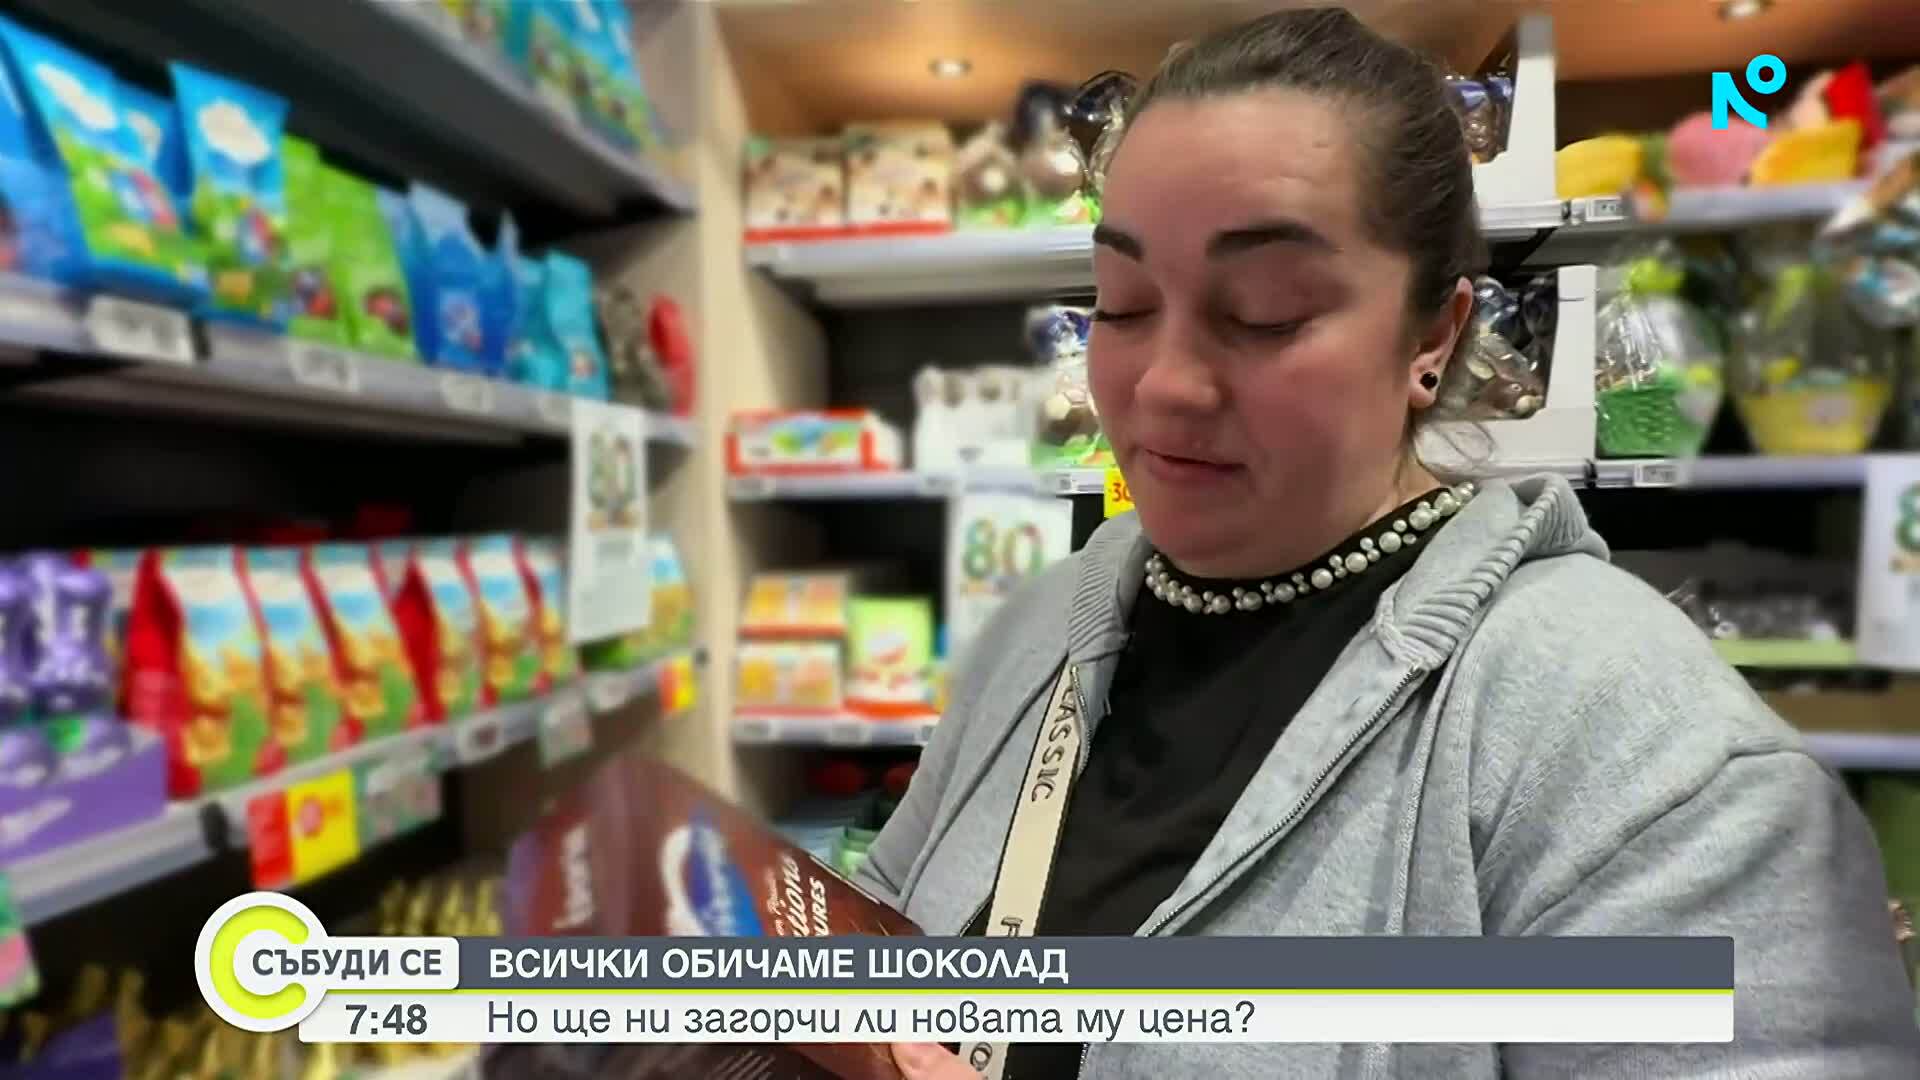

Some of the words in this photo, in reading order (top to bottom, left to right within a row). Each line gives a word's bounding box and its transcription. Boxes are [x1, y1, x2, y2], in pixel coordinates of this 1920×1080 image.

[963, 518, 1044, 580] 80
[1895, 481, 1920, 556] 8
[1030, 685, 1077, 802] LASSIC
[807, 875, 830, 936] URES
